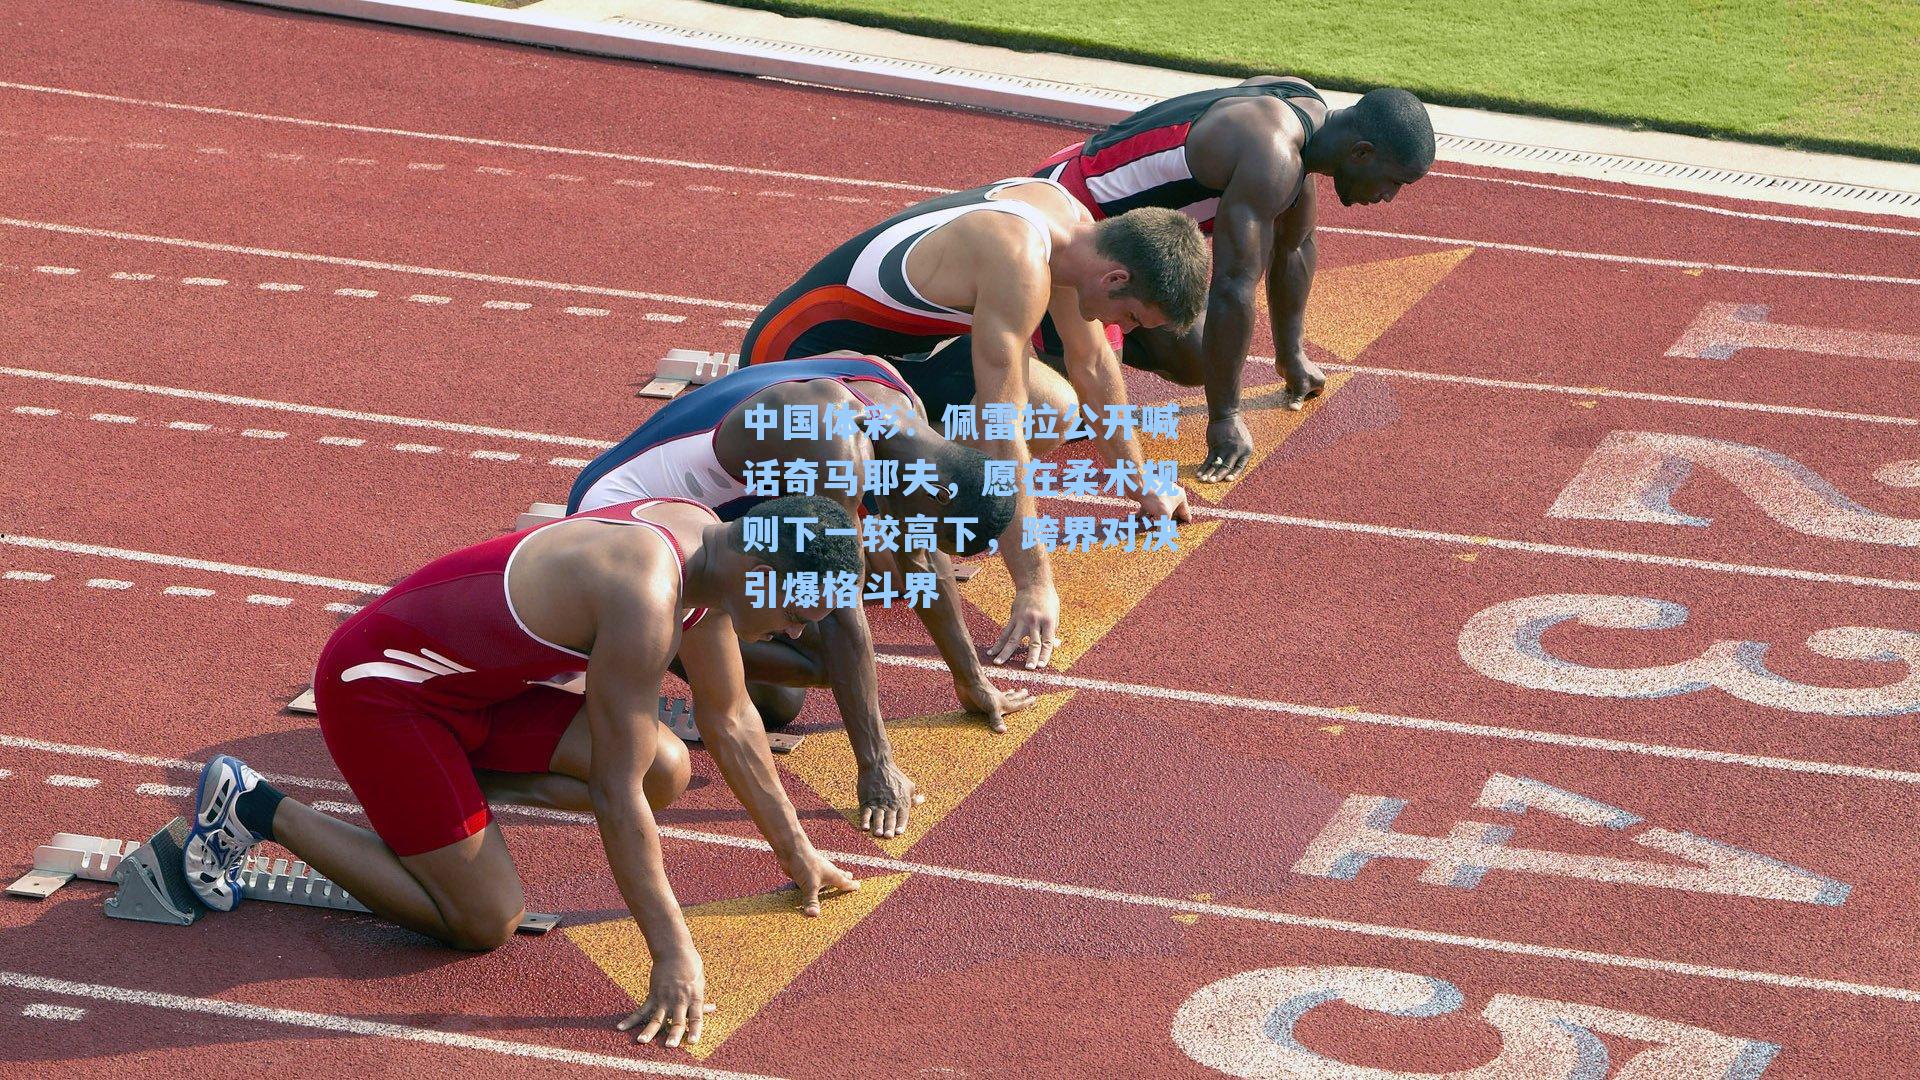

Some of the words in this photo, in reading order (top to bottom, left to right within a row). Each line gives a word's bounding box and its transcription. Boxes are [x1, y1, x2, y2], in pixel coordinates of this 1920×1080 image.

[1547, 430, 1920, 547] 2
[1458, 594, 1920, 717] 3
[1291, 772, 1852, 906] 4
[1171, 965, 1782, 1080] 5
